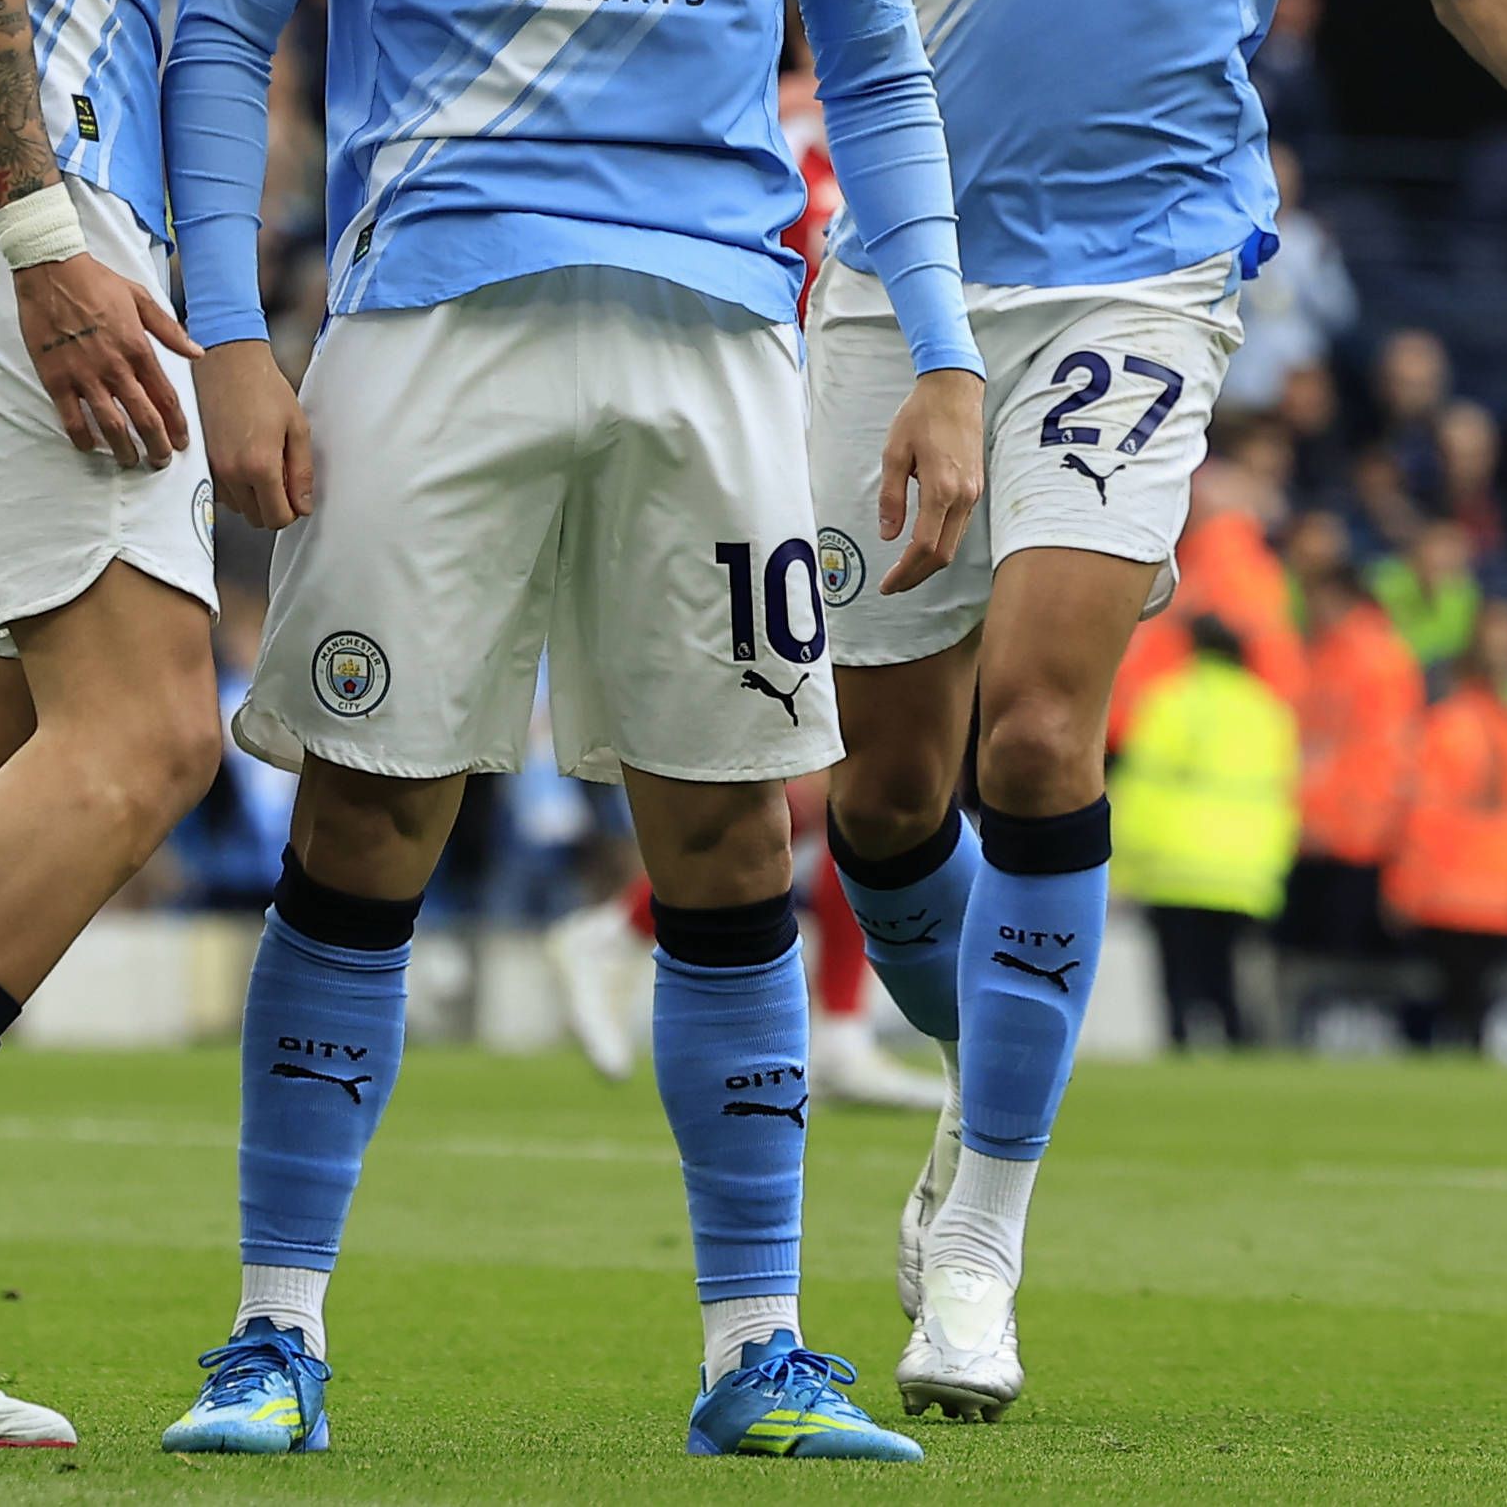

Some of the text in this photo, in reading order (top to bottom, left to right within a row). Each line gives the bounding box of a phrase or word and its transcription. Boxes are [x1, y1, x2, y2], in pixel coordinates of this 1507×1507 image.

[1040, 351, 1184, 456] 27
[715, 538, 825, 664] 10
[321, 638, 381, 666] MANCHESTER
[338, 701, 360, 710] CITY
